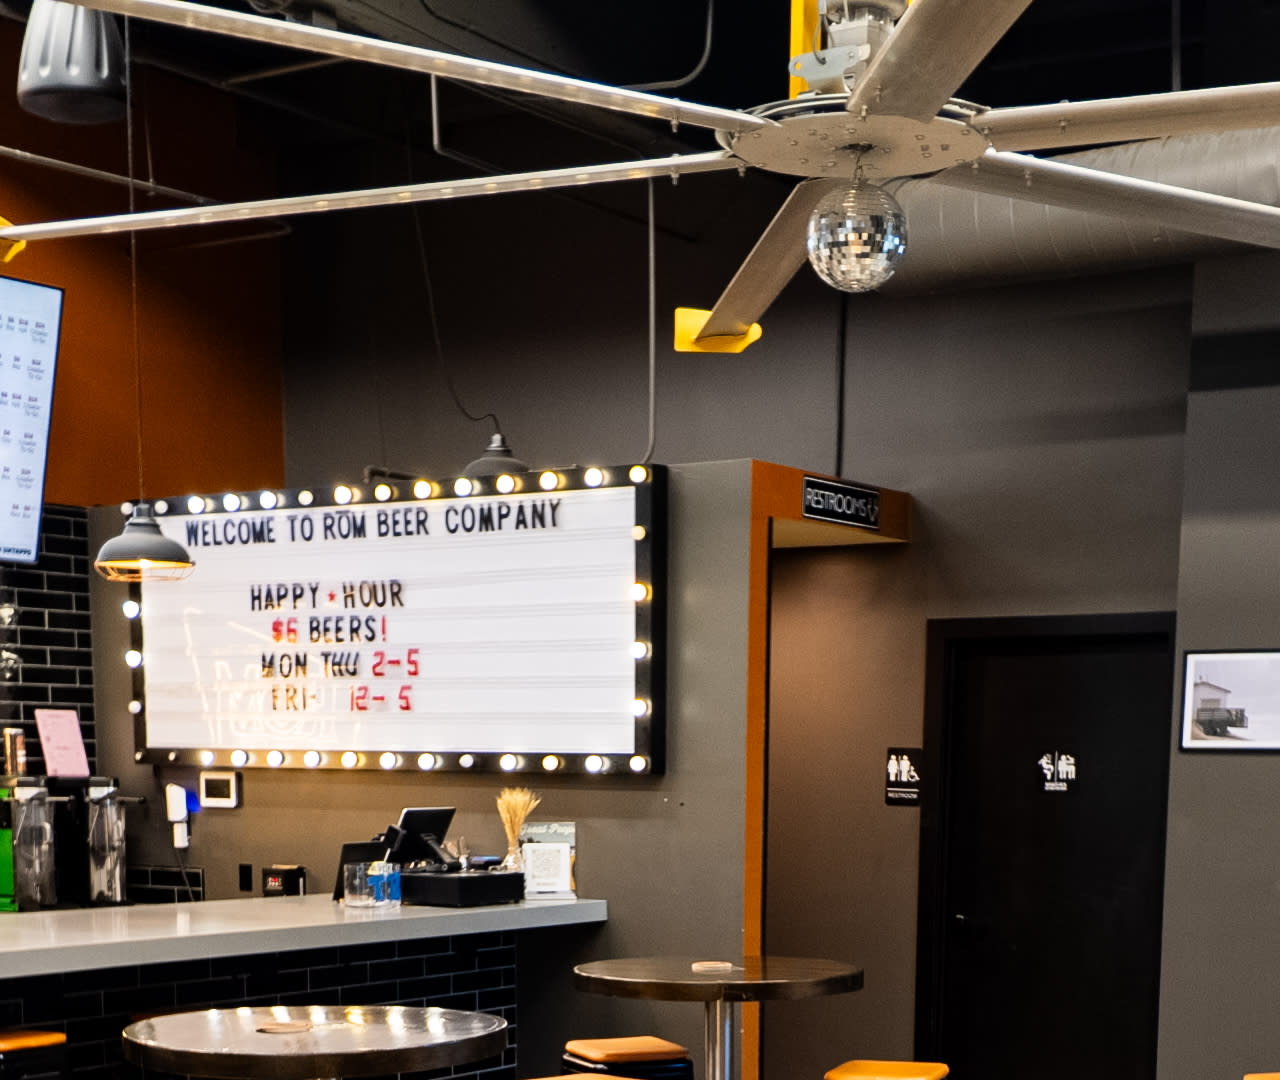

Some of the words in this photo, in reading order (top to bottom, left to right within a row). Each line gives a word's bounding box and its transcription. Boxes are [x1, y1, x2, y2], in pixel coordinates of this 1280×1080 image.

[805, 487, 867, 518] RESTROOMS
[185, 514, 276, 547] WELCOME
[287, 514, 315, 543] TO
[376, 506, 430, 537] BEER
[443, 498, 563, 535] COMPANY
[250, 581, 320, 612] HAPPY
[341, 579, 405, 609] HOUR
[271, 615, 299, 644] $6
[261, 650, 308, 679] MON
[320, 650, 361, 679] THU
